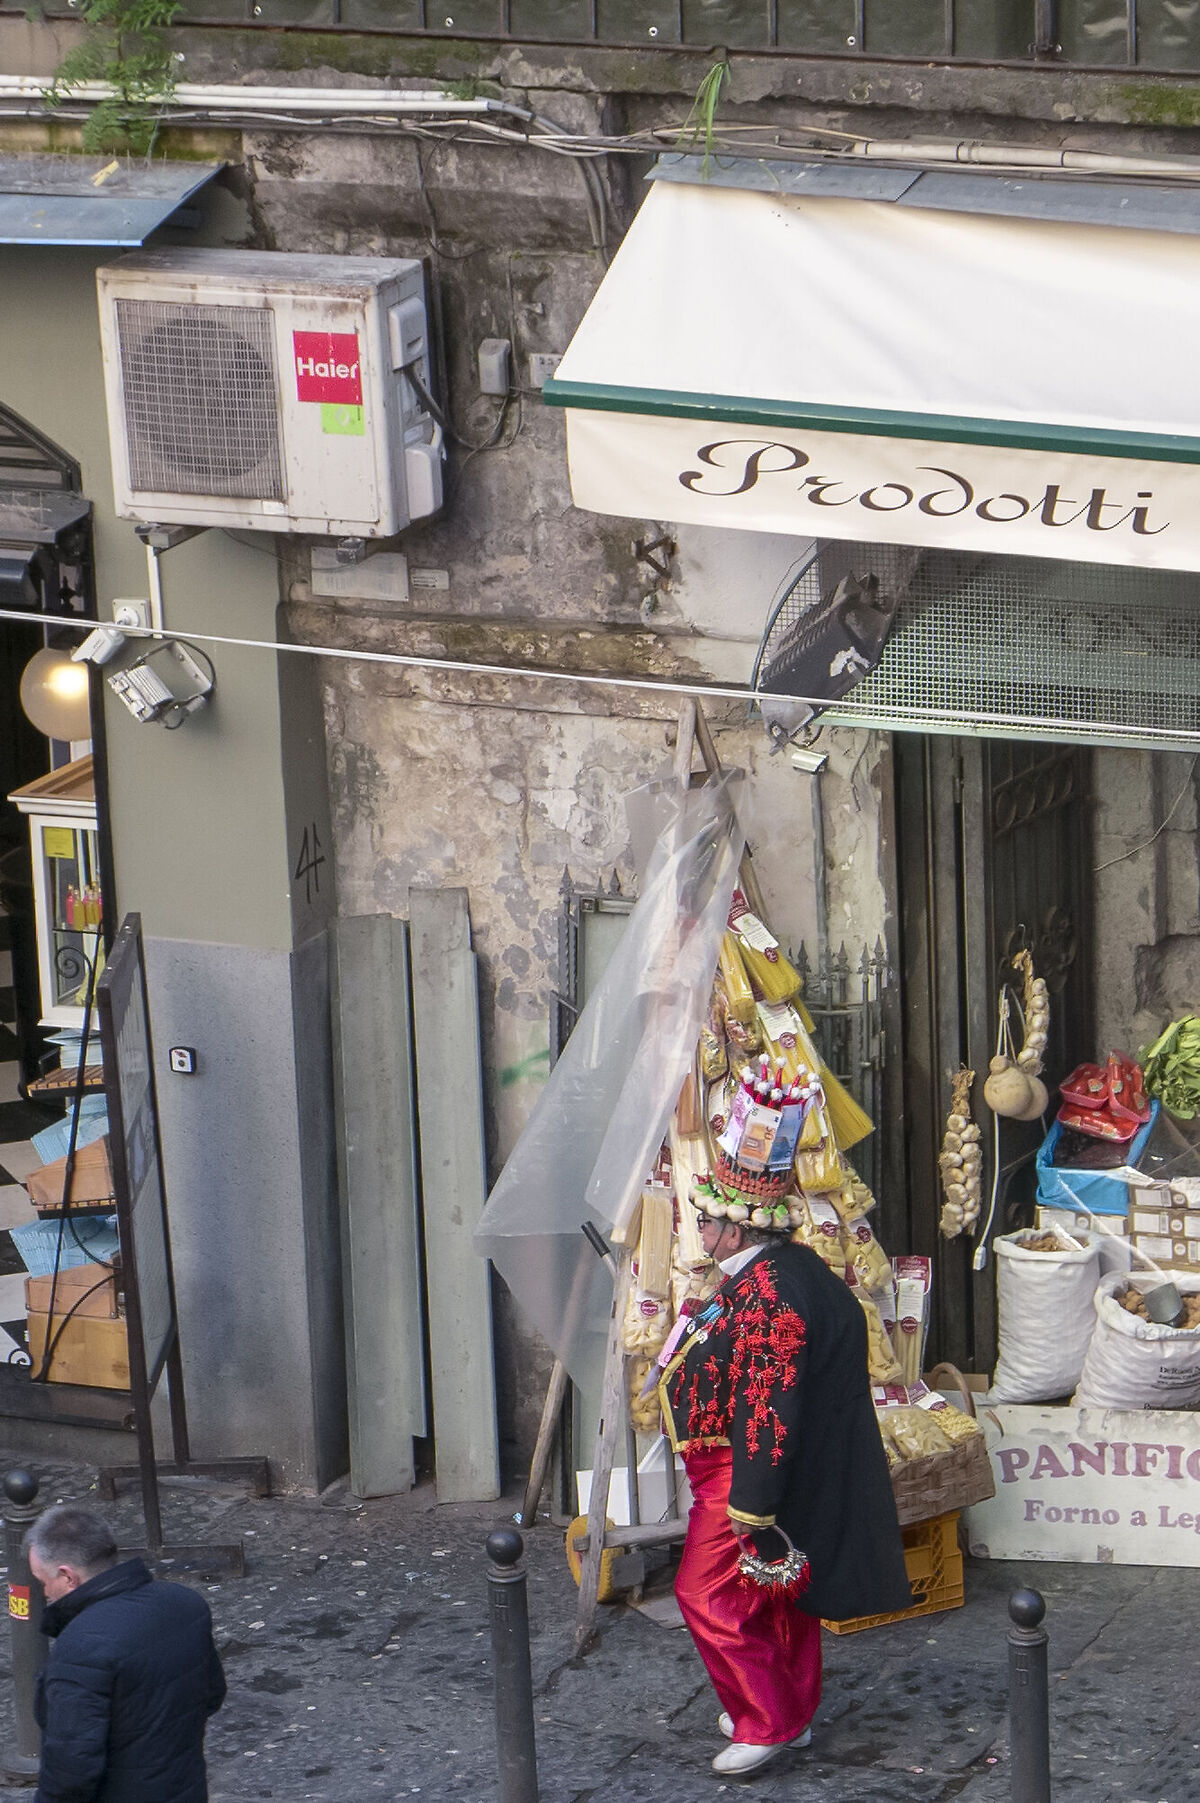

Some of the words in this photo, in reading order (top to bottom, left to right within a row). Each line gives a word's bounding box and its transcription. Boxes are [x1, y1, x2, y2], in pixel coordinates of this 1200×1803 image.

[296, 357, 359, 378] Haier
[679, 439, 1171, 535] Prodotti
[1023, 1499, 1121, 1526] Forno
[1130, 1509, 1148, 1527] a
